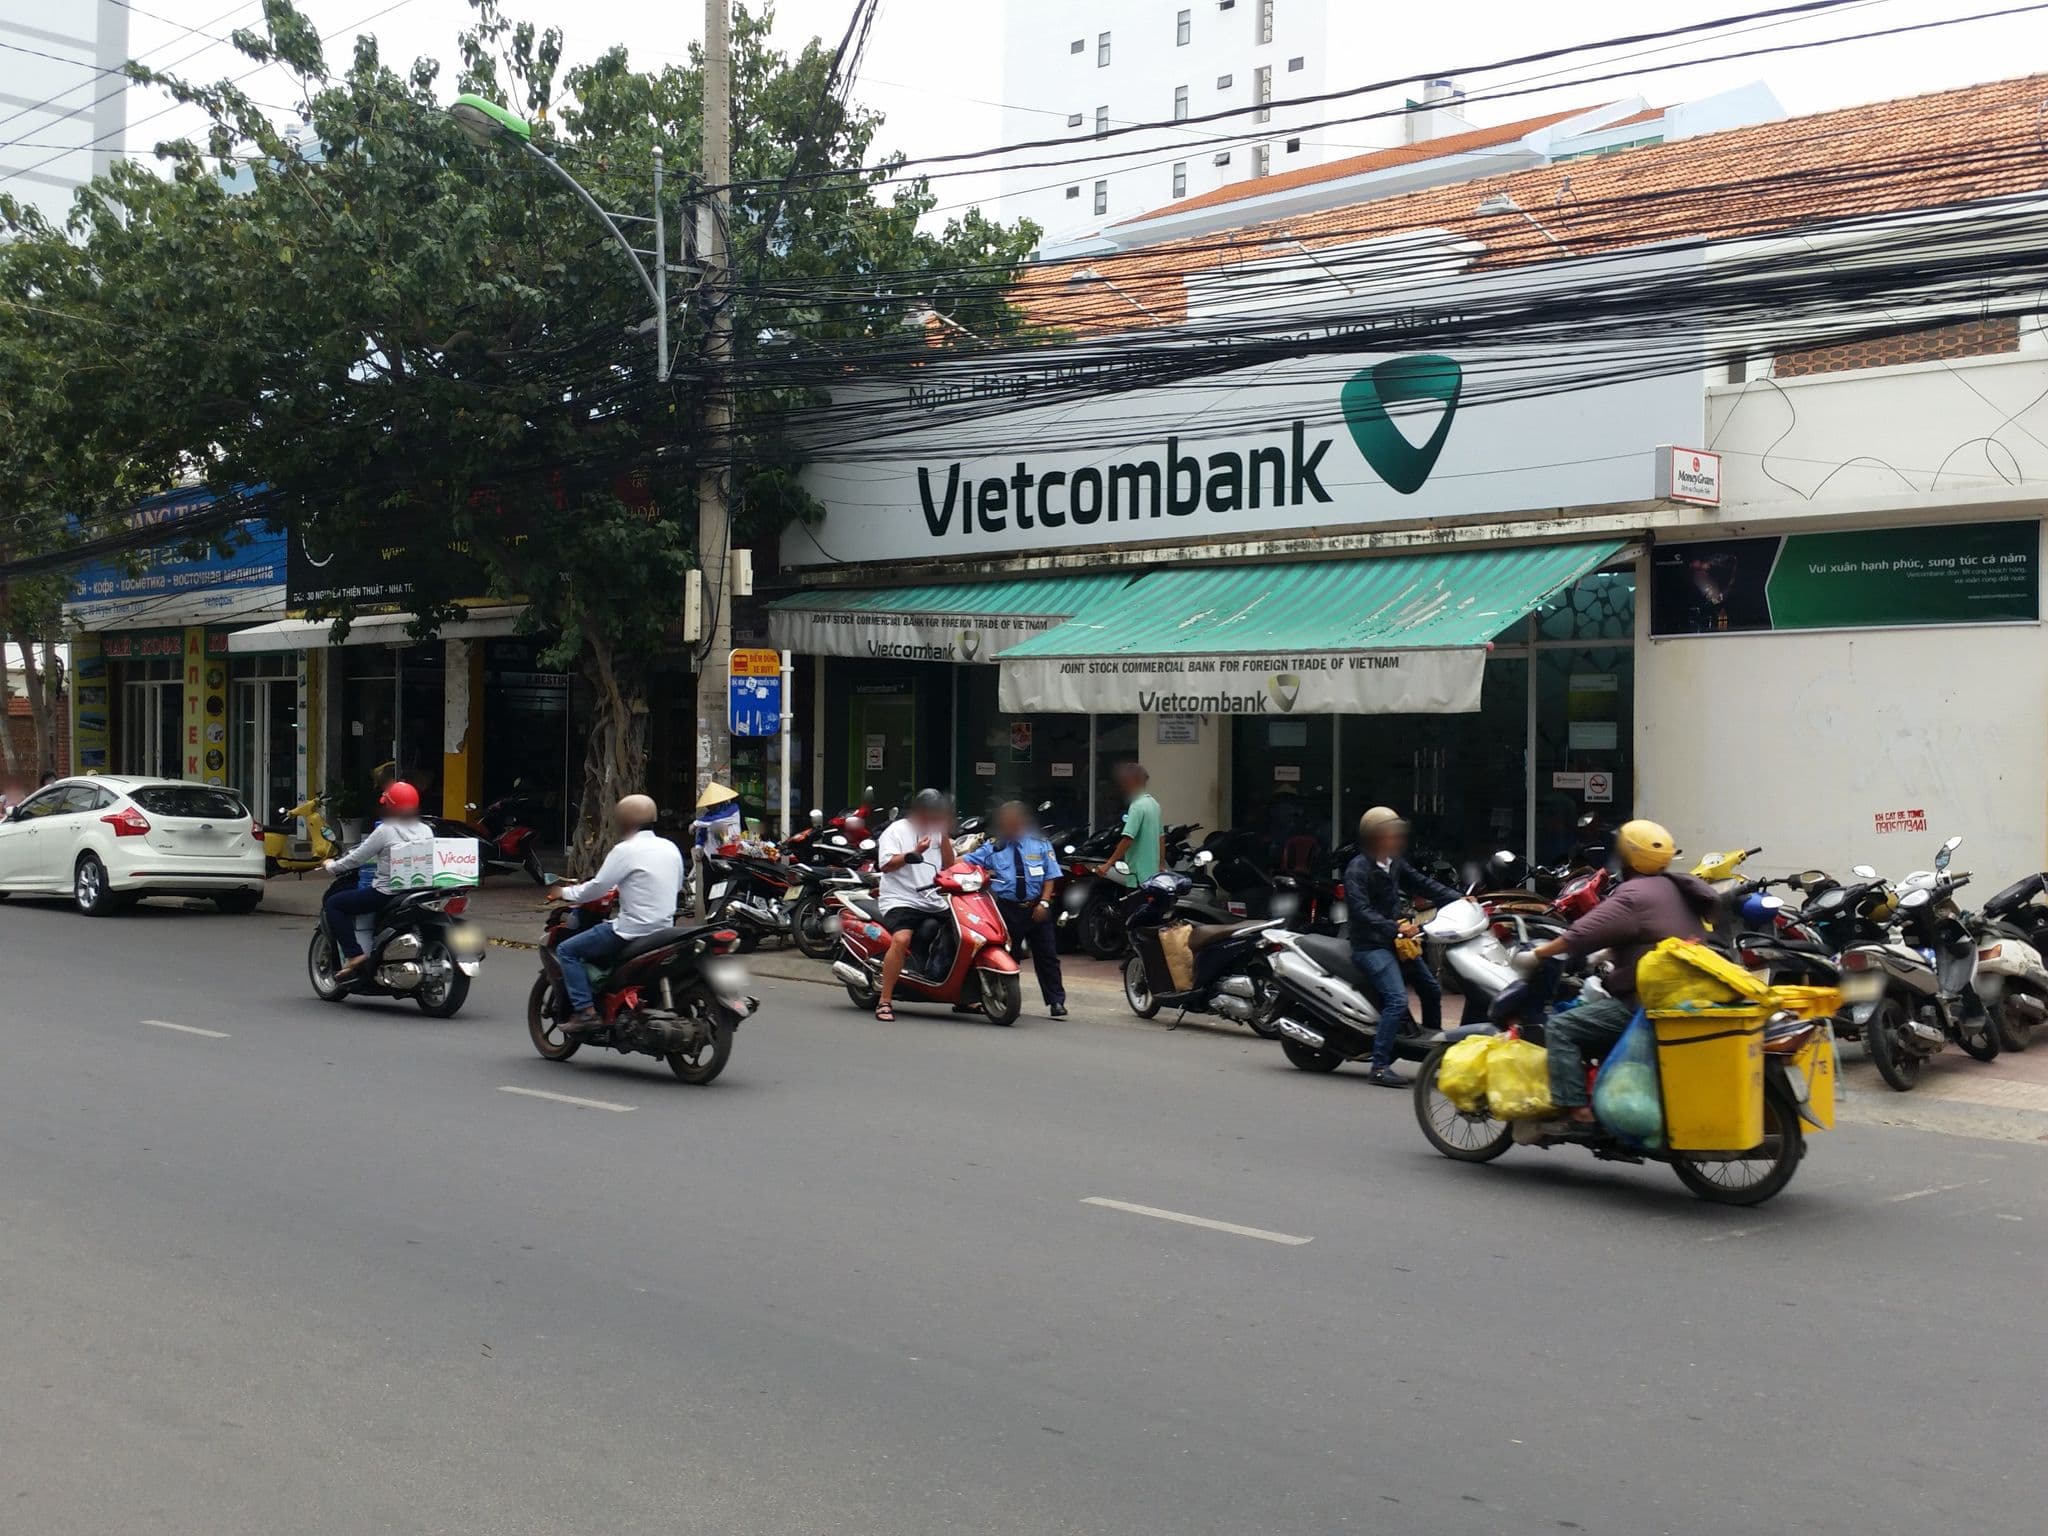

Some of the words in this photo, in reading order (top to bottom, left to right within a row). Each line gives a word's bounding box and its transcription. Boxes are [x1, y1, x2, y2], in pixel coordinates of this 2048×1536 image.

[917, 420, 1335, 536] Vietcombank
[1678, 470, 1715, 486] MoneyGram
[1808, 563, 1827, 574] Vui
[1830, 562, 1858, 573] xuân
[1861, 560, 1889, 572] hạnh
[1893, 558, 1924, 571] phúc,
[1928, 557, 1956, 568] sung
[1959, 554, 1979, 566] túc
[811, 614, 831, 624] JOINT
[856, 614, 901, 626] COMMERCIAL
[903, 616, 924, 627] BANK
[941, 618, 972, 628] FOREIGN
[975, 619, 998, 629] TRADE
[1000, 619, 1011, 629] OF
[1013, 620, 1048, 631] VIETNAM
[867, 639, 956, 660] Vietcombank
[1060, 662, 1086, 674] JOINT
[1089, 662, 1119, 673] STOCK
[1122, 661, 1185, 673] COMMERCIAL
[1188, 660, 1216, 672] BANK
[1219, 660, 1240, 672] FOR
[1242, 658, 1288, 672] FOREIGN
[1291, 657, 1327, 671] TRADE
[1331, 657, 1345, 670] OF
[1348, 656, 1399, 670] VIETNAM
[1138, 690, 1268, 713] Vietcombank
[437, 850, 477, 867] Vikoda
